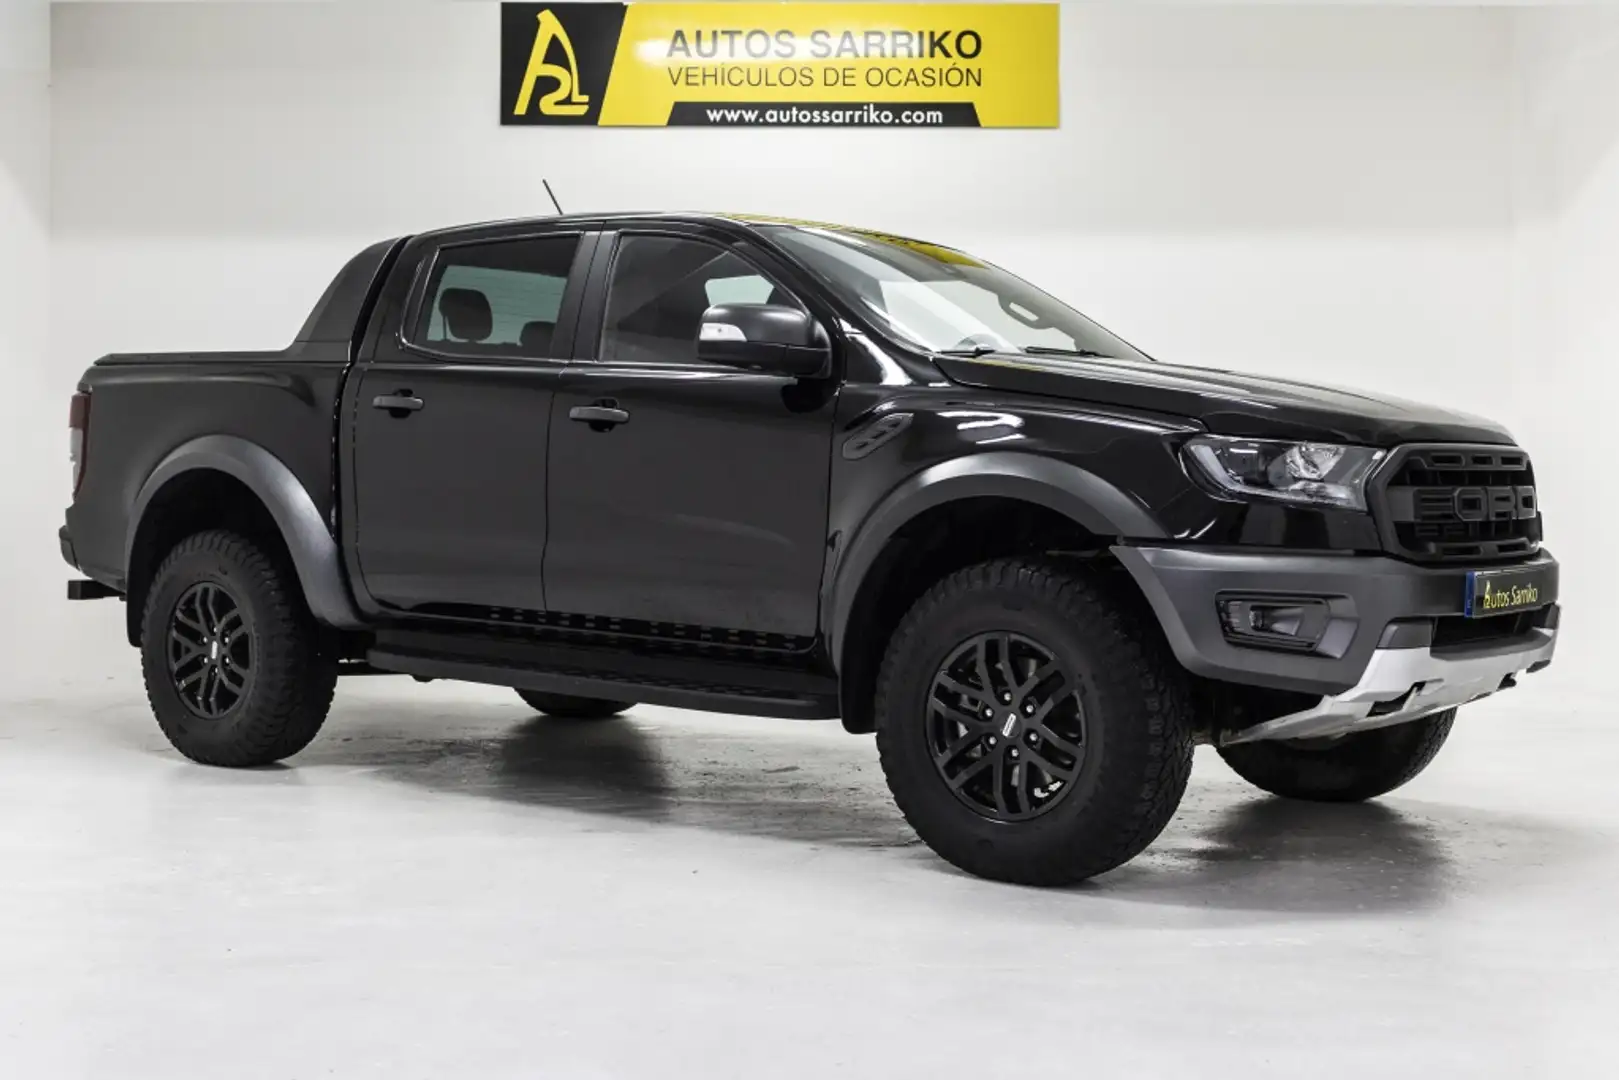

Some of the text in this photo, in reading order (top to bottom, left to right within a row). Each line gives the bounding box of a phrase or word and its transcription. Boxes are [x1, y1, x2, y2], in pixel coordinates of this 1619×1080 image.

[666, 29, 982, 59] AUTOS SARRIKO
[667, 62, 982, 87] VEHÍCULOS DE OCASIÓN
[705, 103, 943, 124] www.autossarriko.com
